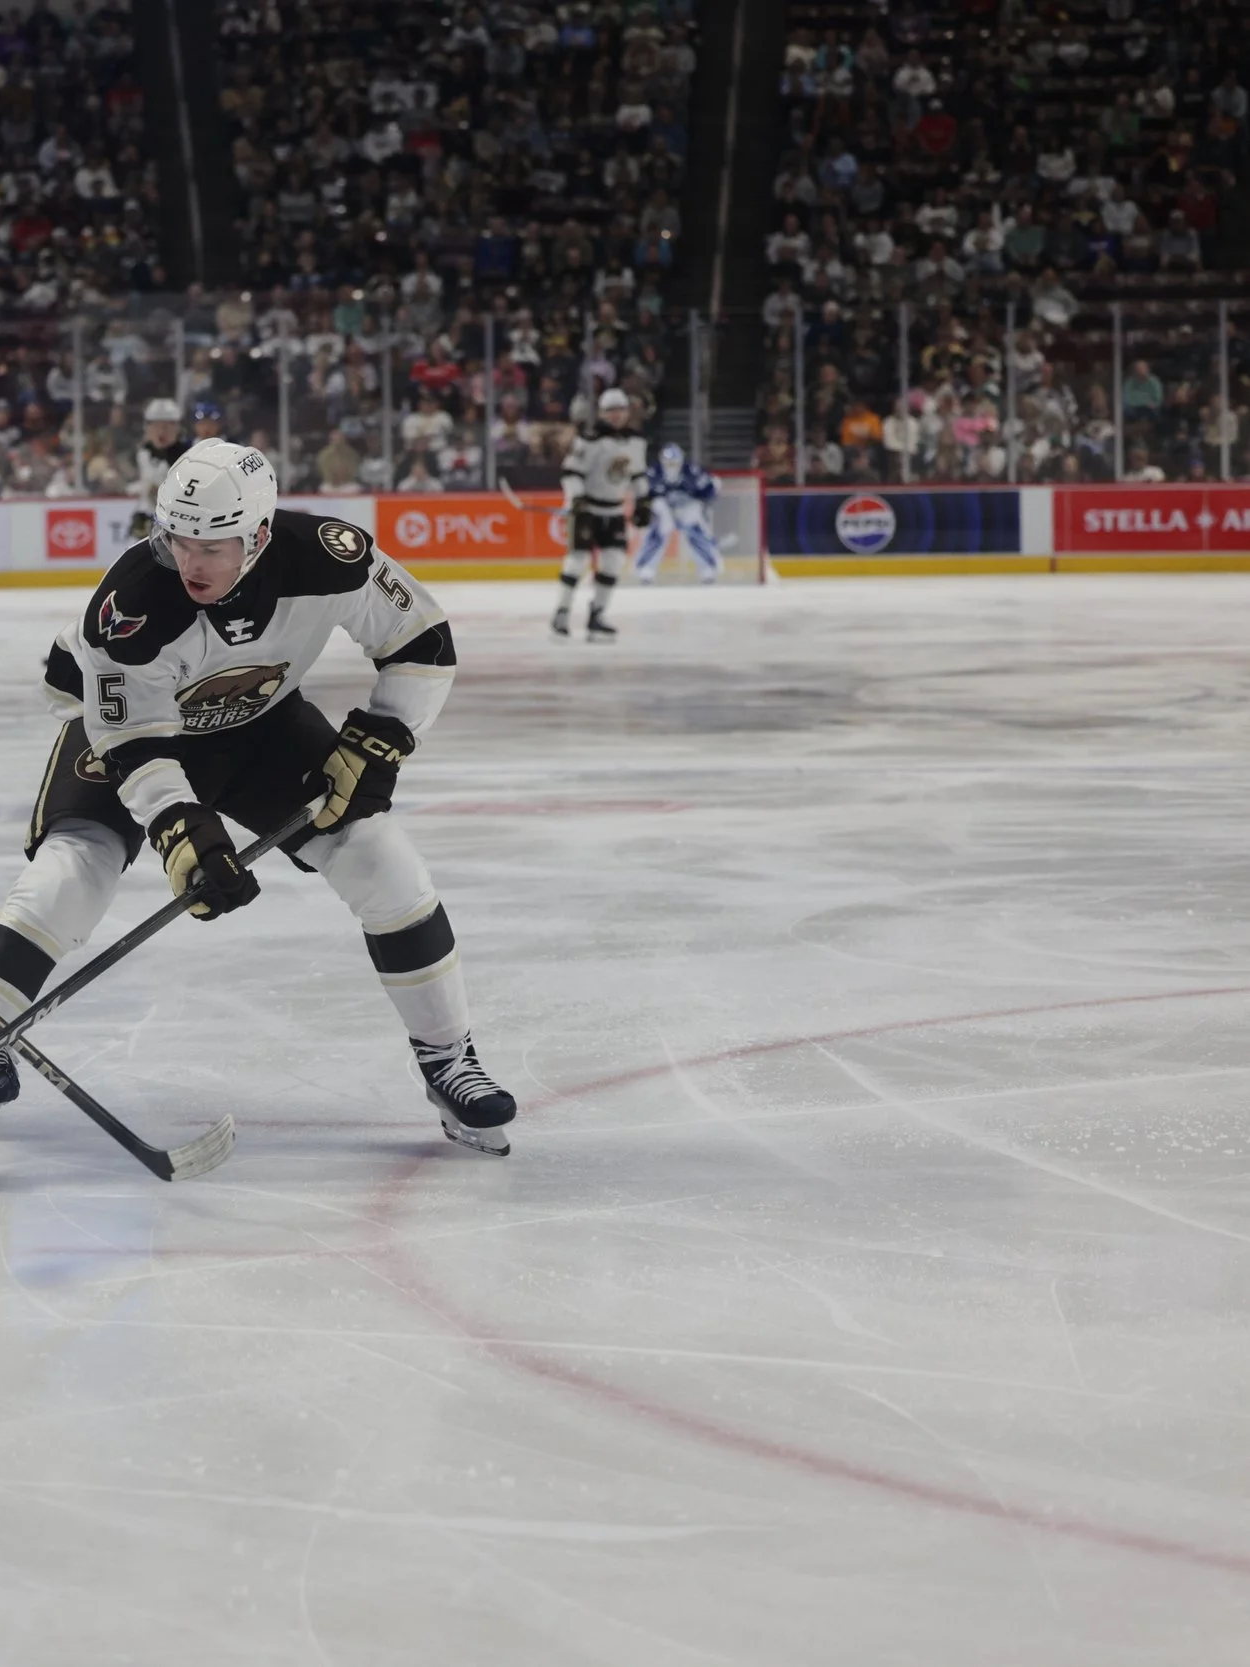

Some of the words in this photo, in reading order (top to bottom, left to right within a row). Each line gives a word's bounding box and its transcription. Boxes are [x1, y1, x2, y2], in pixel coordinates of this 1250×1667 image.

[184, 478, 199, 497] 5
[170, 510, 201, 523] CCM
[434, 512, 508, 545] PNC
[1083, 508, 1190, 533] STELLA
[373, 562, 413, 612] 5
[96, 673, 129, 726] 5
[195, 705, 248, 717] HERSHEY
[184, 708, 252, 729] BEARS
[341, 726, 408, 769] CCM
